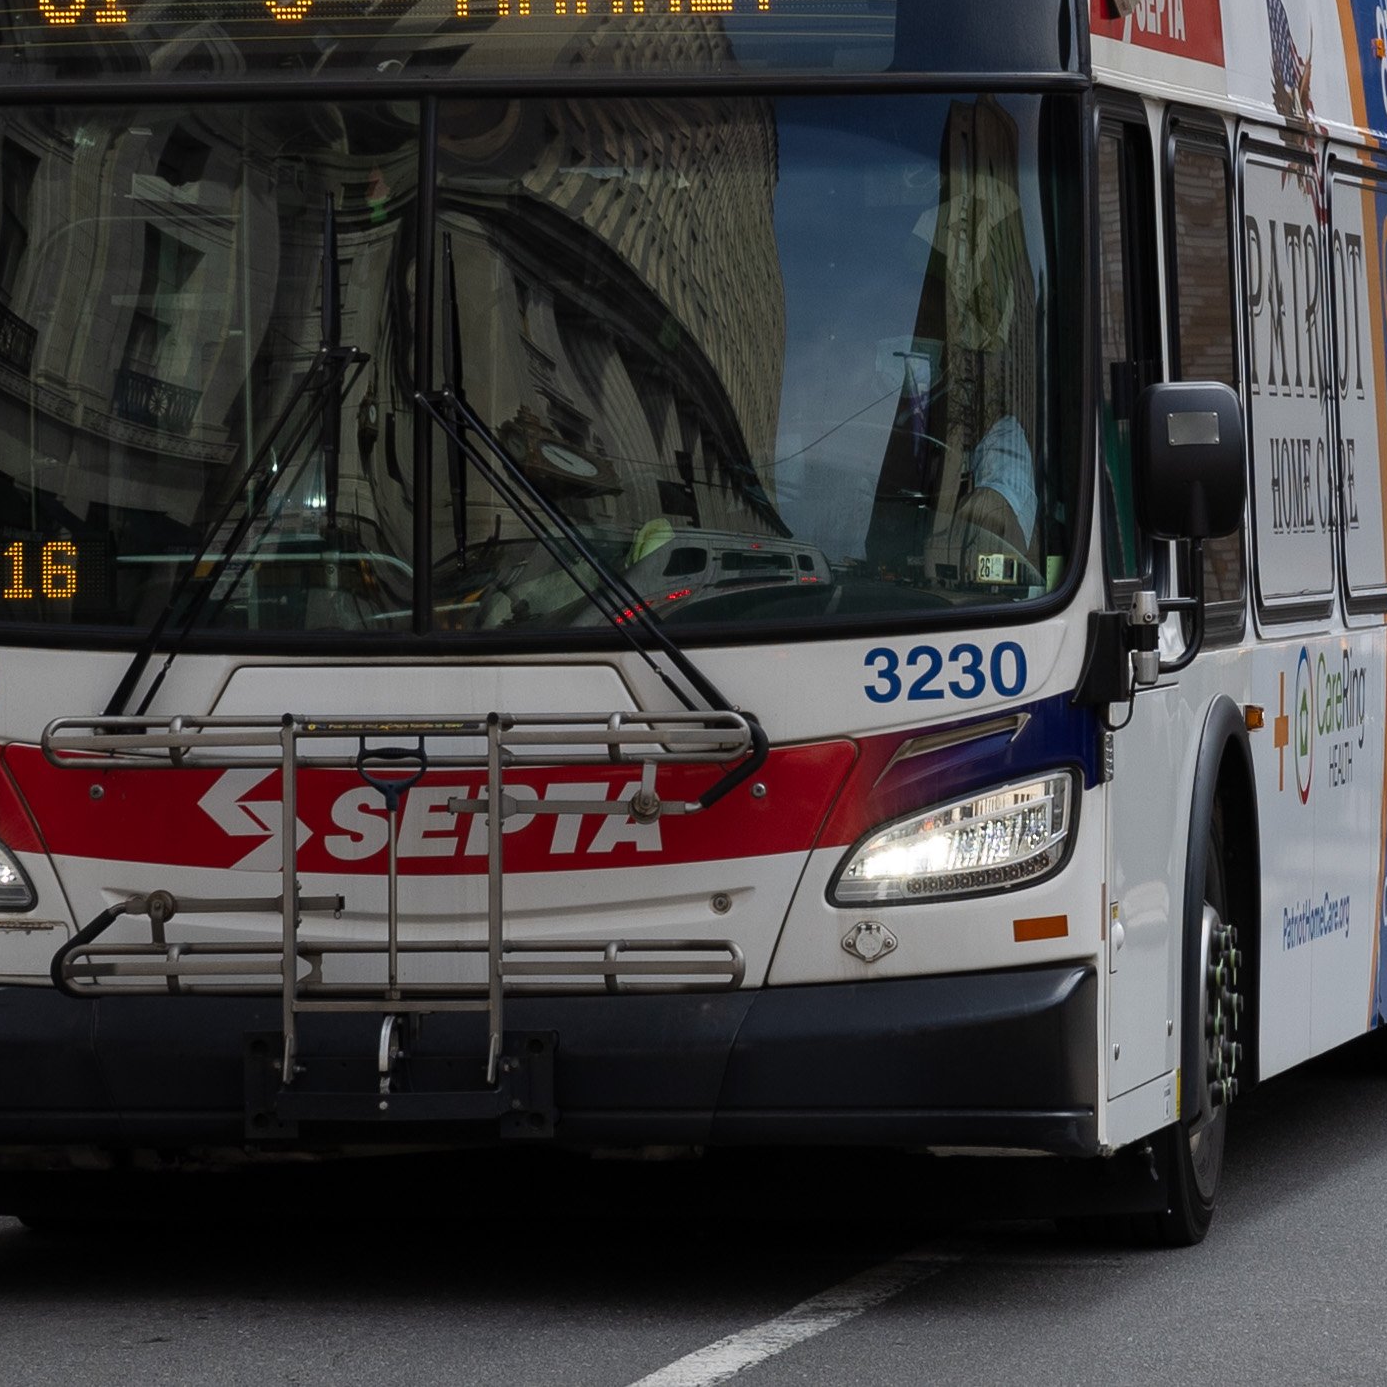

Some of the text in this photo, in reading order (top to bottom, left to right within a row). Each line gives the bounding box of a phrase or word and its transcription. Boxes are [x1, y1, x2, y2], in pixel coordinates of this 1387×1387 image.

[1245, 215, 1366, 414] PATROT
[1270, 438, 1315, 534] HOME
[864, 641, 1028, 703] 3230
[1316, 647, 1366, 749] CareRing
[1328, 741, 1353, 789] HEALTH
[323, 780, 664, 862] SEPTA
